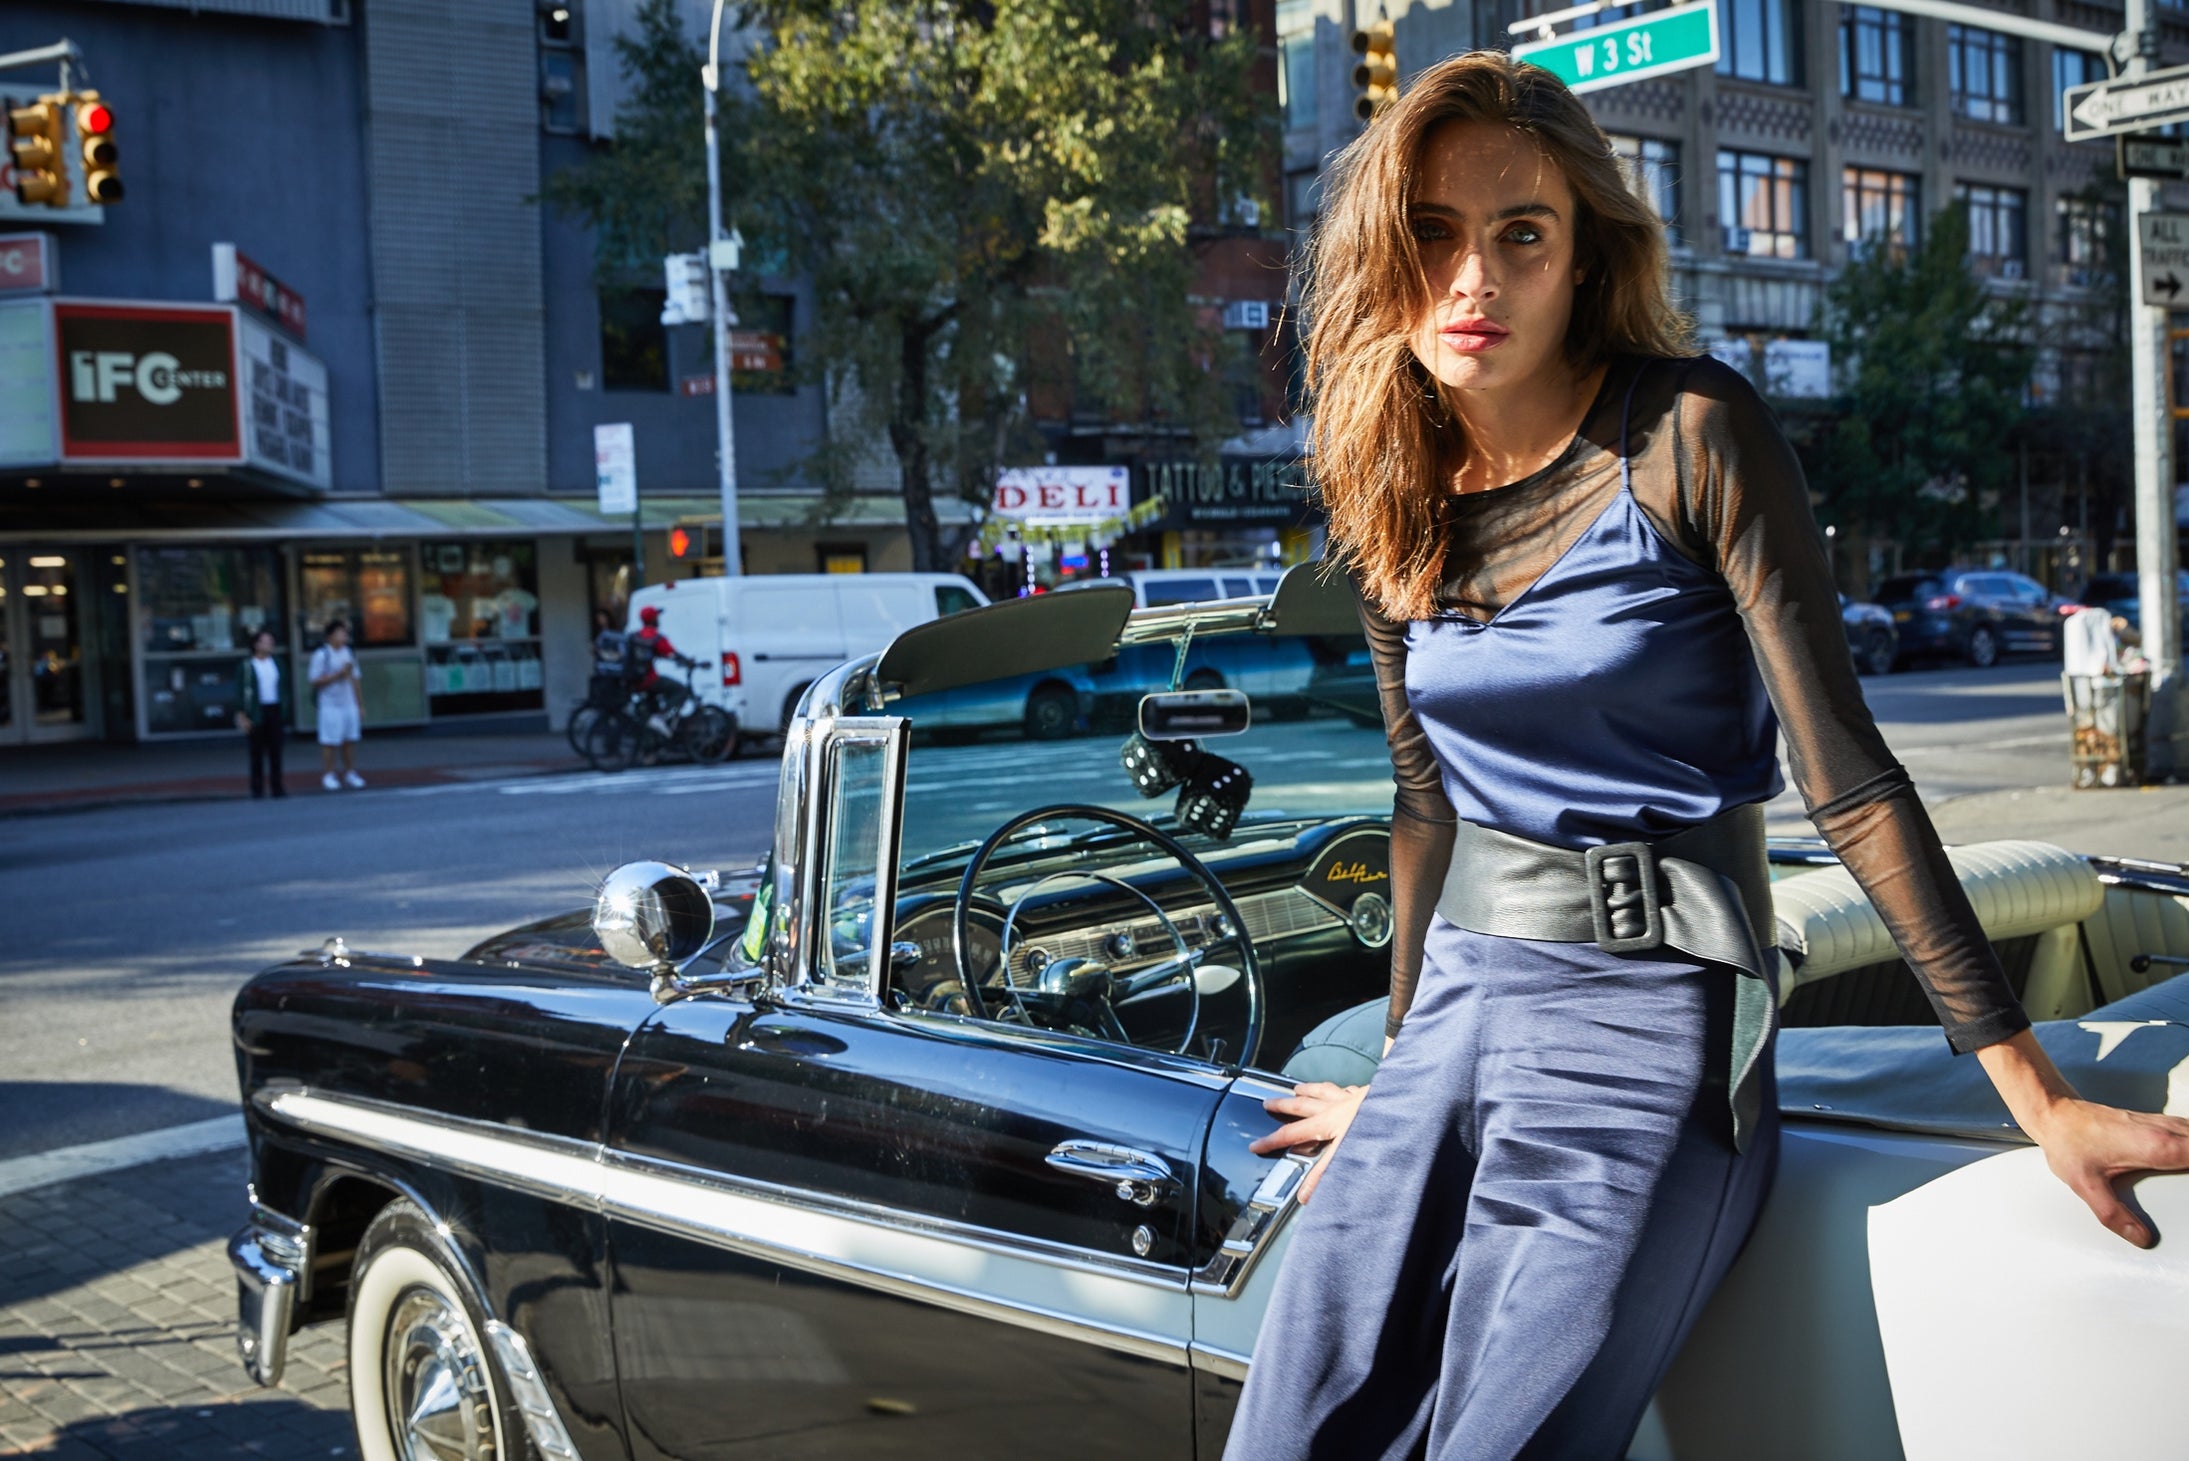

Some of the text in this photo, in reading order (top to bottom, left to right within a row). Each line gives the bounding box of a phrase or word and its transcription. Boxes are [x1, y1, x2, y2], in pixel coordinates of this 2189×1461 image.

[1574, 30, 1653, 77] W 3 St
[2087, 83, 2188, 119] ONE WAY
[2151, 220, 2181, 243] ALL
[154, 370, 227, 388] CENTER
[997, 484, 1119, 510] DELI
[1146, 462, 1225, 503] TATTOO
[1229, 463, 1246, 497] &
